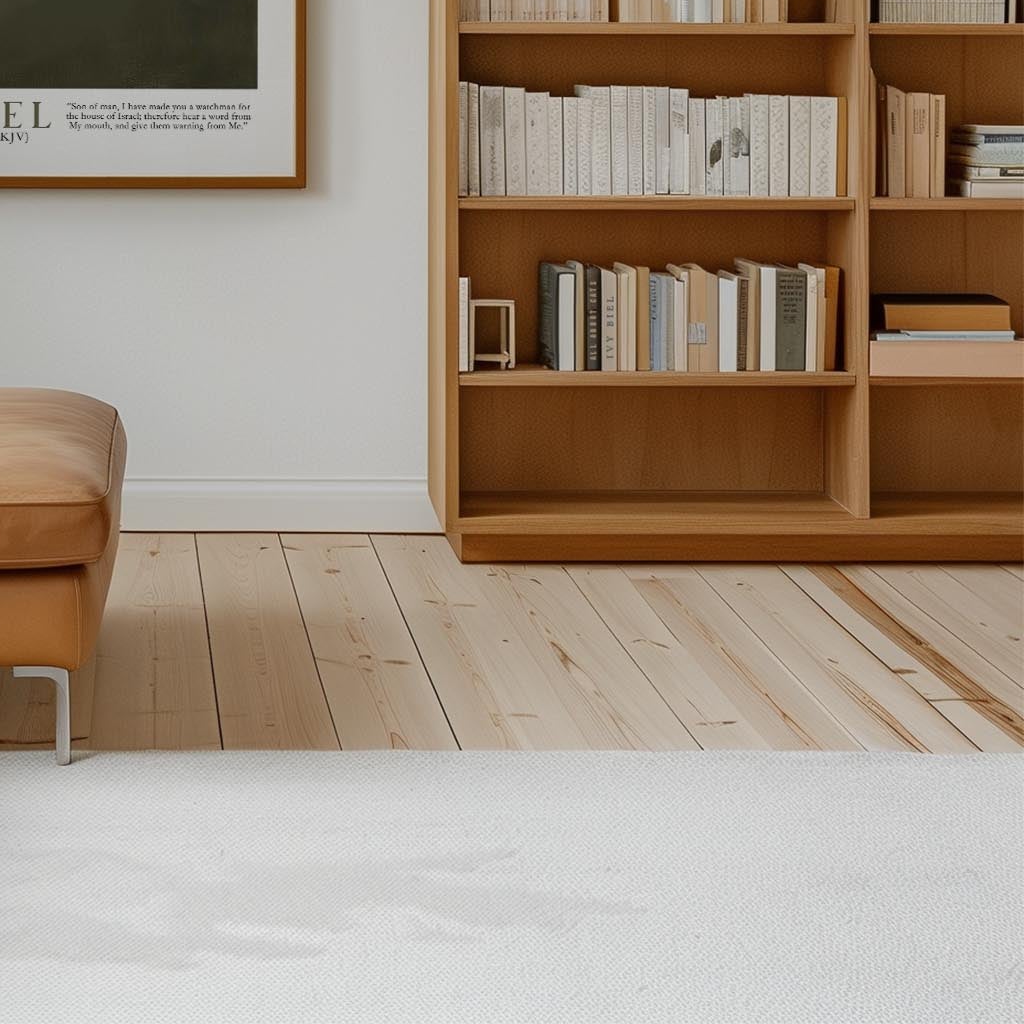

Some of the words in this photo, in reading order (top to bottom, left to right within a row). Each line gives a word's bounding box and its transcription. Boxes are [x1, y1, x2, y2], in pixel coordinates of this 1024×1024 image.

[66, 112, 79, 120] the
[81, 112, 104, 120] house
[106, 112, 116, 120] of
[144, 112, 180, 120] therefore
[182, 112, 200, 120] hear
[208, 112, 229, 120] word
[231, 112, 252, 120] from
[89, 102, 98, 110] of
[99, 104, 119, 112] man,
[127, 102, 147, 110] have
[148, 102, 170, 110] made
[195, 102, 236, 110] watchman
[238, 102, 251, 110] for
[69, 121, 82, 131] My
[84, 121, 112, 130] mouth,
[114, 121, 129, 129] and
[130, 121, 148, 131] give
[150, 121, 170, 129] them
[173, 121, 205, 131] warning
[207, 121, 226, 129] from
[589, 281, 598, 304] CATS
[605, 296, 615, 327] BIEL
[589, 310, 598, 339] ABOUT
[589, 344, 598, 361] ALL
[605, 336, 615, 359] IVY
